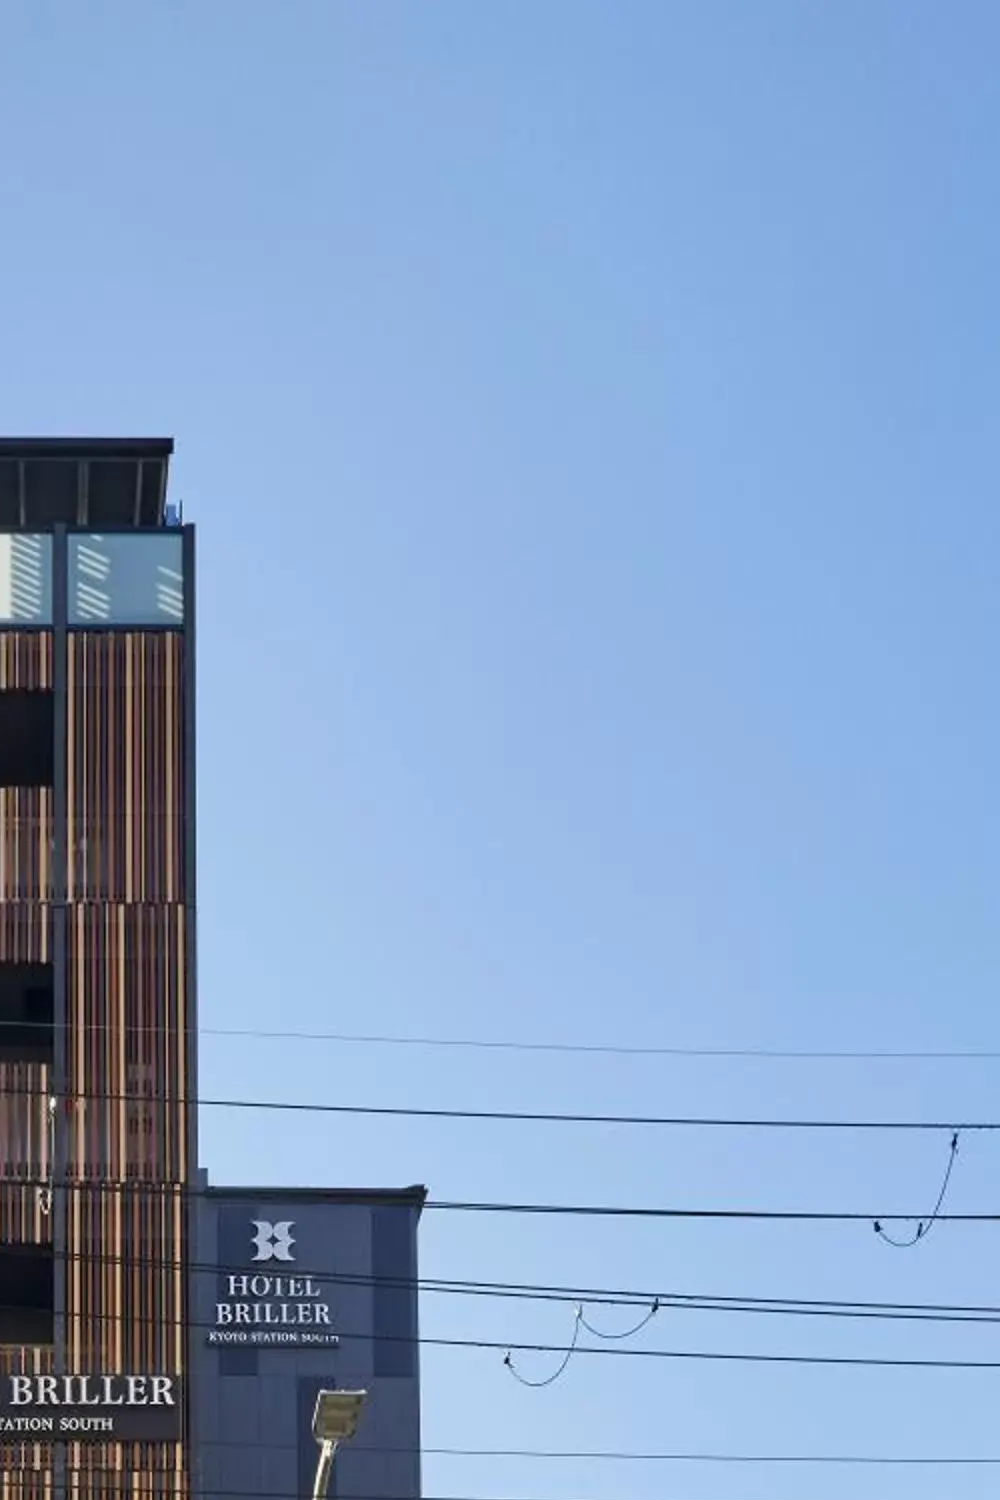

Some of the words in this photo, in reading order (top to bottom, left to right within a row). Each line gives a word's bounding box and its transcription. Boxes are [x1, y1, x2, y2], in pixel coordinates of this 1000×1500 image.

[227, 1275, 321, 1297] HOTEL
[216, 1303, 332, 1325] BRILLER
[209, 1331, 247, 1342] KYOTO
[251, 1331, 298, 1342] STATION
[9, 1374, 176, 1406] BRILLER
[59, 1417, 114, 1431] SOUTH
